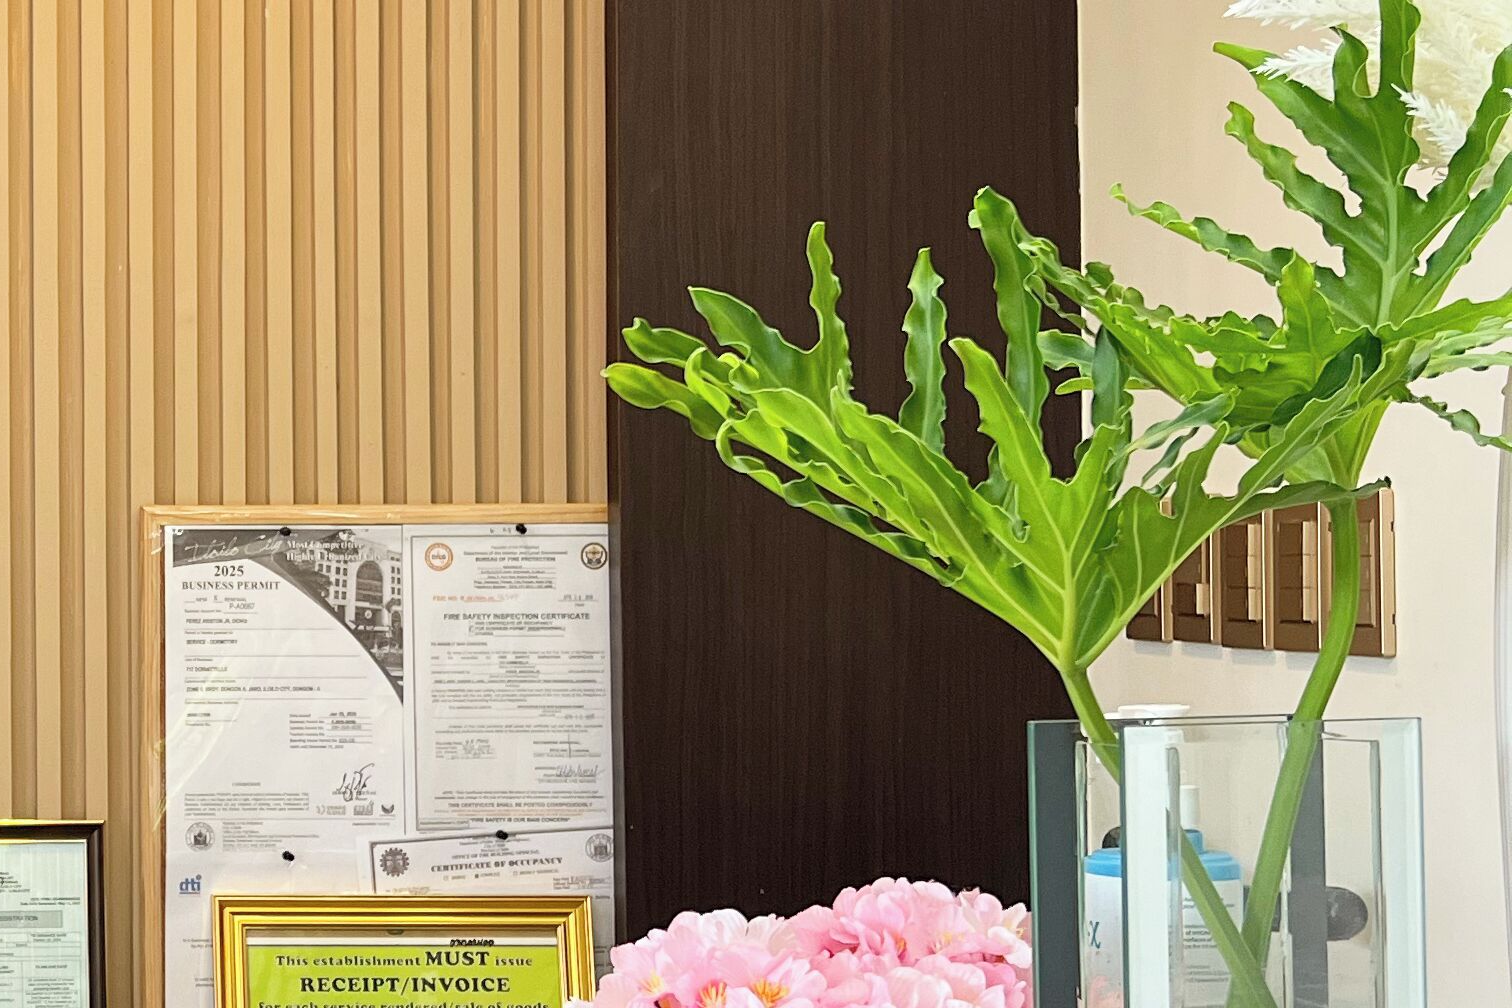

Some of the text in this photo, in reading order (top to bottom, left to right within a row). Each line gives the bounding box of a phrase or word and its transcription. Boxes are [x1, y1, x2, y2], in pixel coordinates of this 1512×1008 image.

[214, 566, 244, 577] 2025
[182, 581, 280, 590] BUSINESS PERMIT
[431, 857, 562, 872] CERTIFICATE OF OCCUPANCY
[179, 874, 202, 892] dti
[276, 951, 533, 966] This establishment MUST issue
[300, 976, 511, 996] RECEIPT/INVOICE
